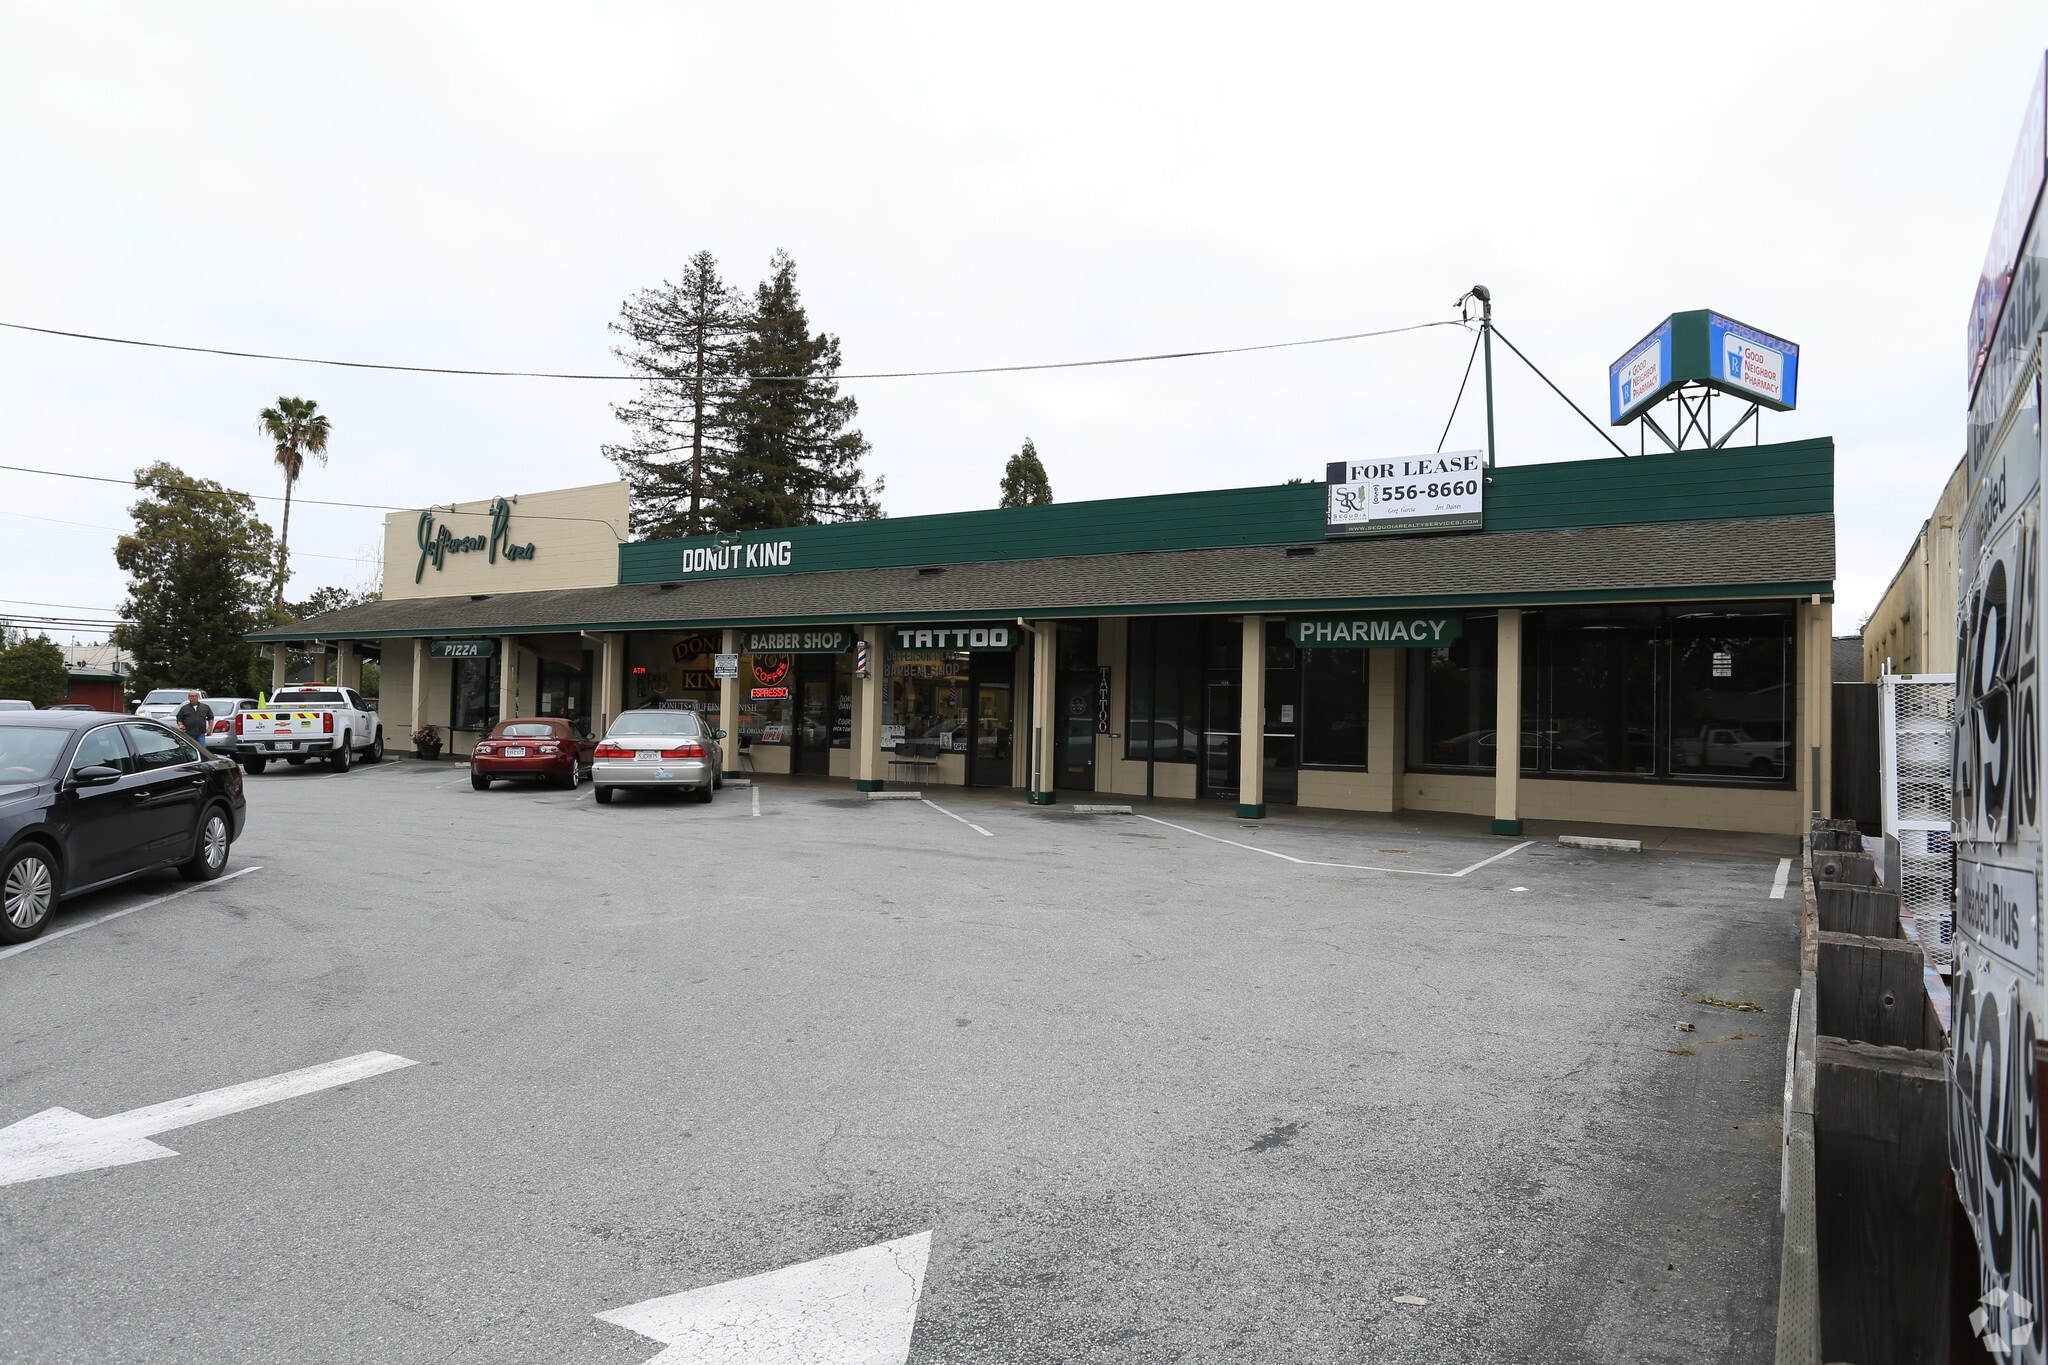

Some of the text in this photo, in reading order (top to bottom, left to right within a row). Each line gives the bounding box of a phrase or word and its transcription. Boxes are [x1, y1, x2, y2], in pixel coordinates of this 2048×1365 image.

[2000, 88, 2042, 272] SHOP
[1999, 227, 2041, 406] PRICE
[1711, 314, 1798, 357] JEFFERSON PLAZA
[1744, 347, 1764, 364] GOOD
[1632, 359, 1647, 376] GOOD
[1632, 364, 1657, 387] NEIGHBOR
[1744, 359, 1777, 382] NEIGHBOR
[1632, 375, 1659, 400] PHARMACY
[1744, 373, 1779, 395] PHARMACY
[1351, 455, 1478, 481] FOR LEASE
[1382, 480, 1478, 502] 556-8660
[415, 497, 536, 584] Jefferson Plaza
[683, 541, 792, 573] DONUT KING
[751, 632, 842, 650] BARBER SHOP
[898, 628, 1008, 648] TATTOO
[1300, 620, 1447, 642] PHARMACY
[444, 644, 478, 656] PIZZA
[632, 667, 647, 675] ATM
[754, 662, 787, 683] COFFEE
[884, 663, 961, 677] BARBER SHOP
[751, 688, 788, 699] ESPRESSO
[1099, 667, 1109, 733] TATTOO
[691, 702, 721, 712] MUFFIN
[738, 703, 757, 712] NISH
[763, 732, 782, 742] OPEN
[954, 742, 967, 751] OPEN
[1993, 883, 2019, 950] Plus
